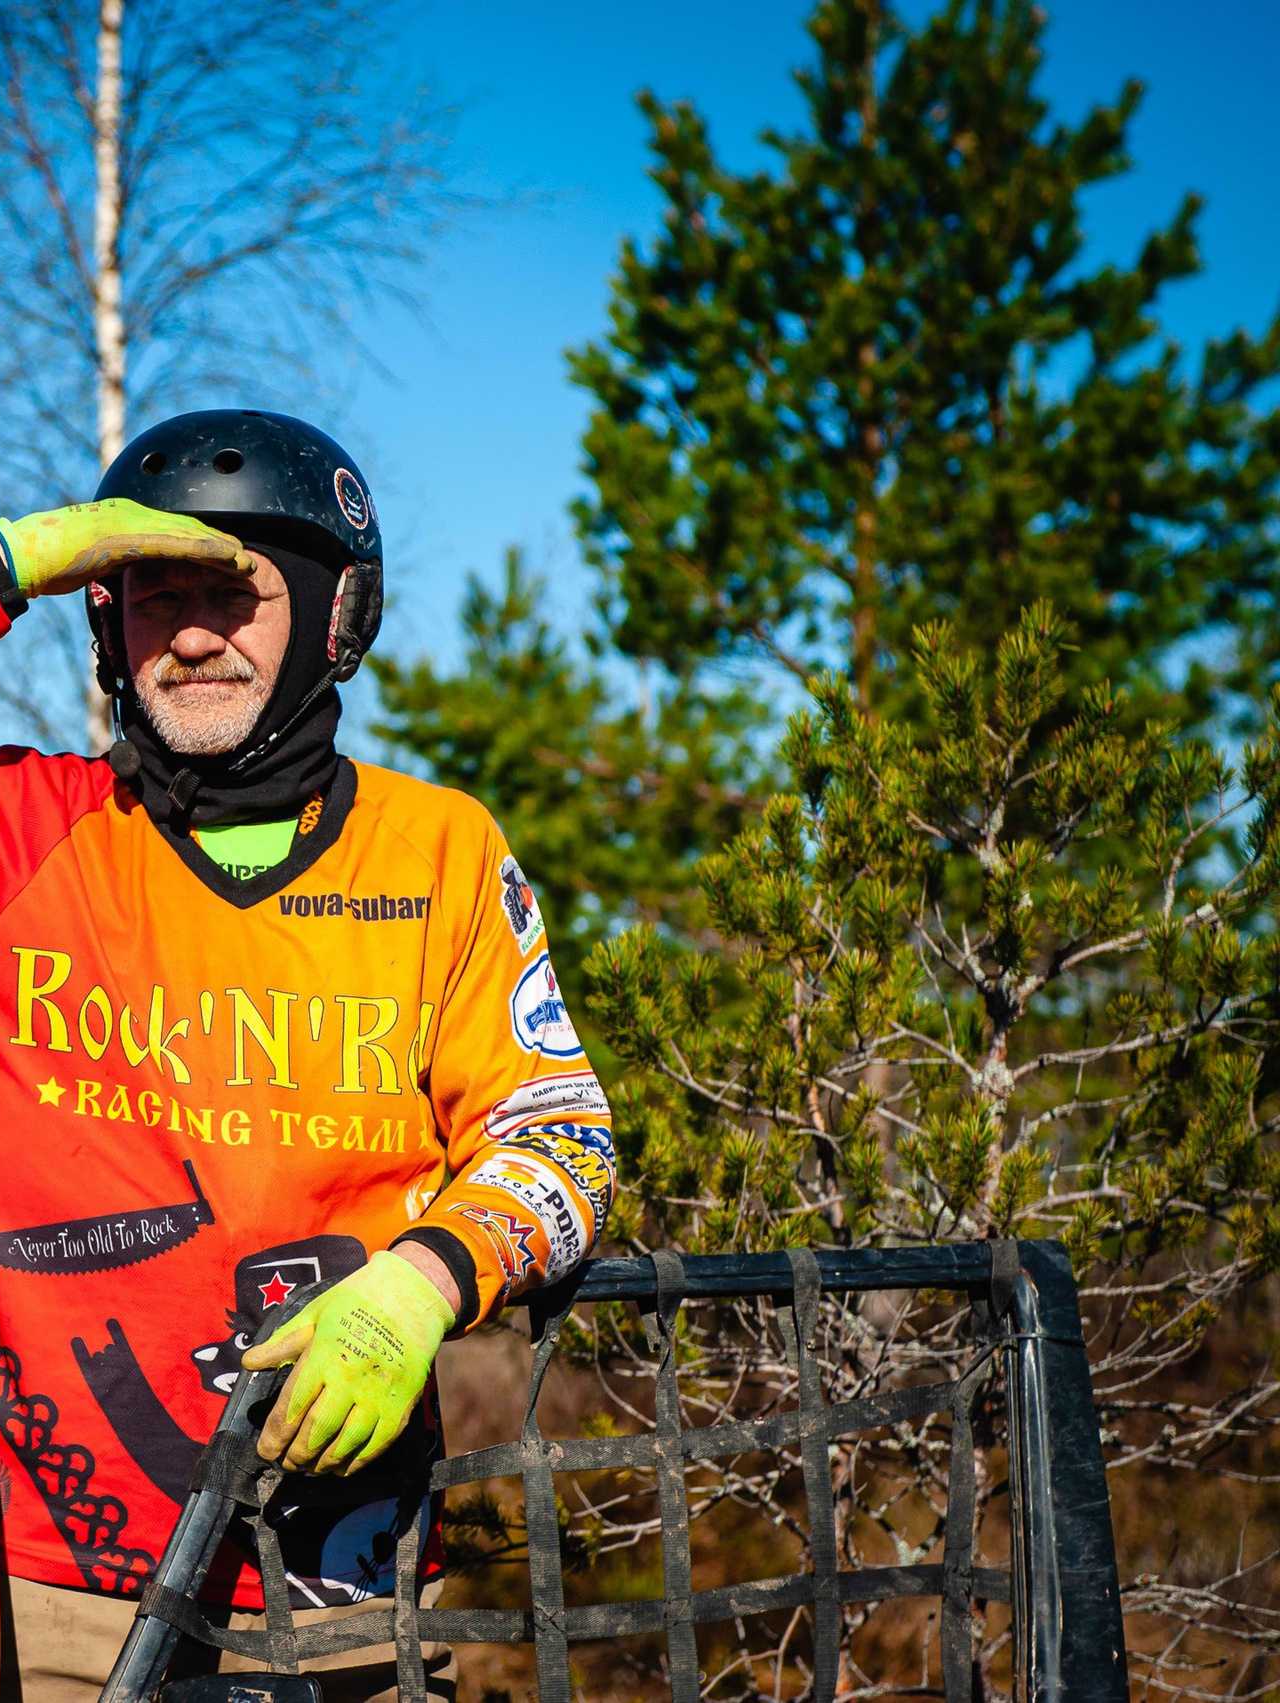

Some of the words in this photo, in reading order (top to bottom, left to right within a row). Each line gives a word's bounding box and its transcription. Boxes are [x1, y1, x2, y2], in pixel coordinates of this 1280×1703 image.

[299, 791, 323, 835] XXIS
[279, 893, 431, 921] vova-subar
[73, 1079, 252, 1145] RACING
[270, 1109, 408, 1153] TEAM
[8, 1237, 56, 1263] Never
[58, 1228, 85, 1258] Too
[87, 1223, 114, 1256] Old
[115, 1219, 134, 1250] To
[136, 1214, 179, 1245] Rock
